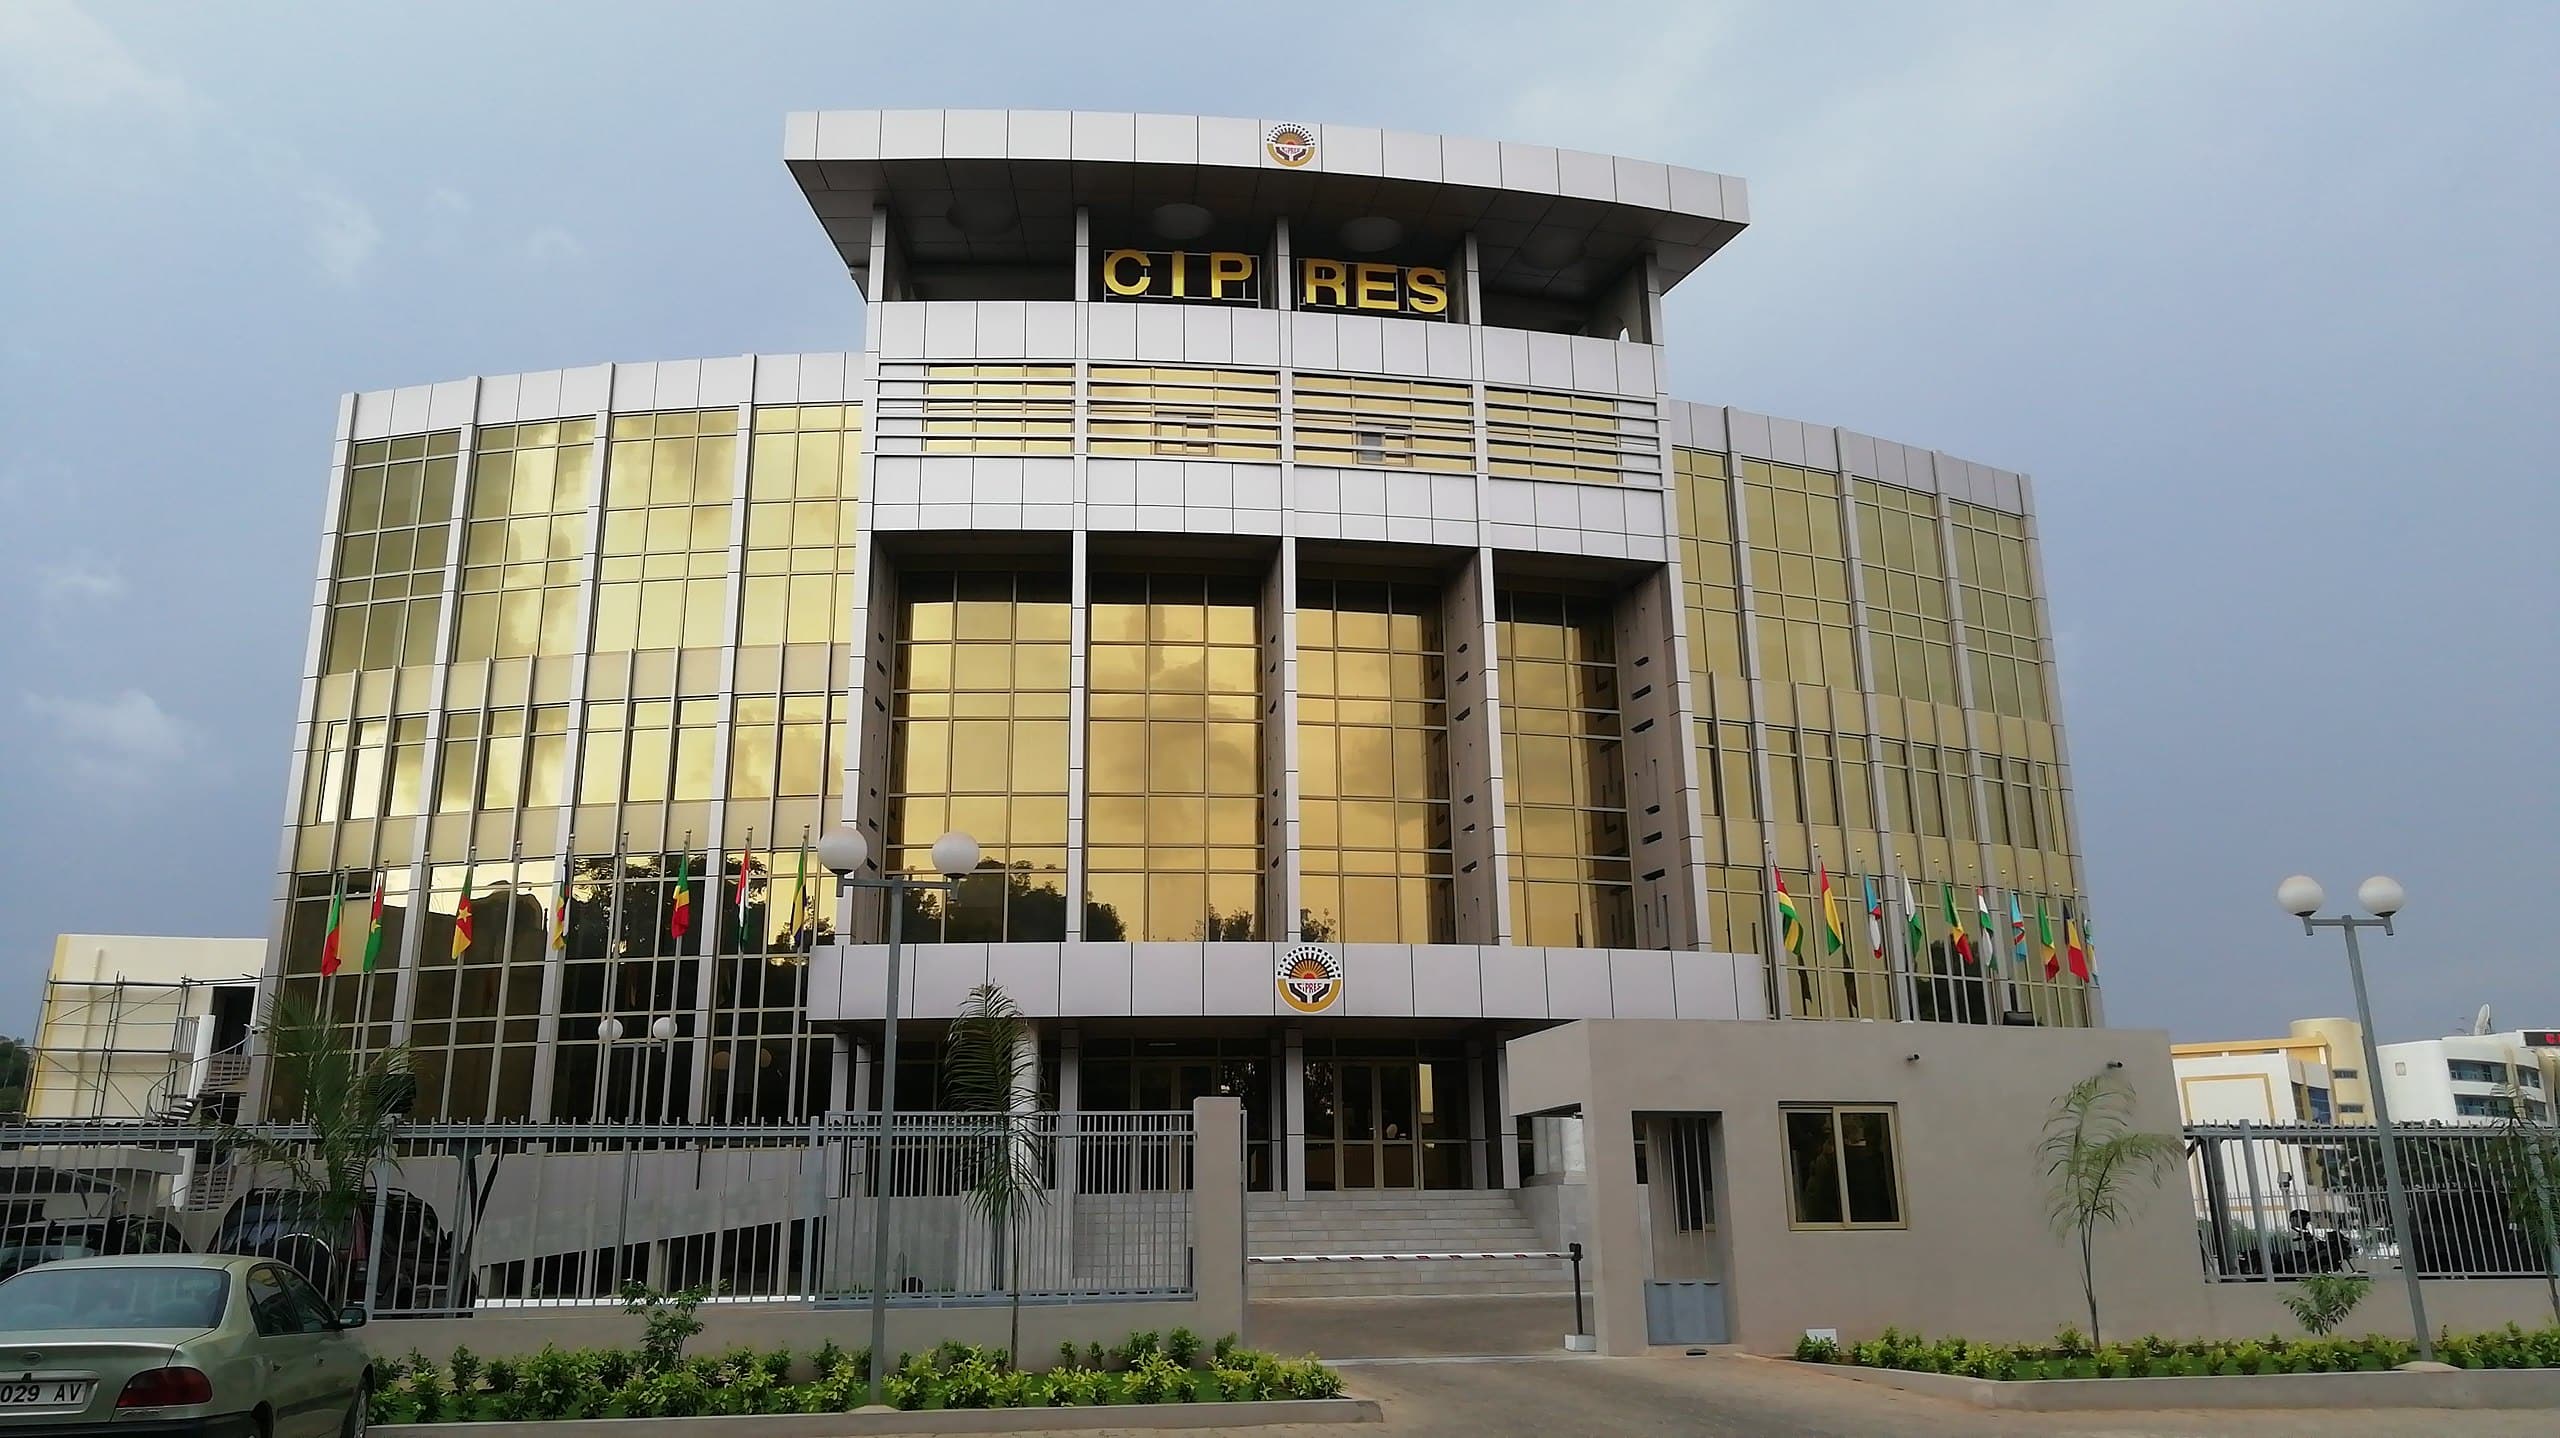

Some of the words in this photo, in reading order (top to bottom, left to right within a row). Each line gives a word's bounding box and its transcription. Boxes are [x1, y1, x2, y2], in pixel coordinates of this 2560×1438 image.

[1104, 249, 1252, 298] CIP
[1306, 258, 1448, 313] RES
[0, 1385, 40, 1402] 029
[54, 1384, 82, 1401] AV
